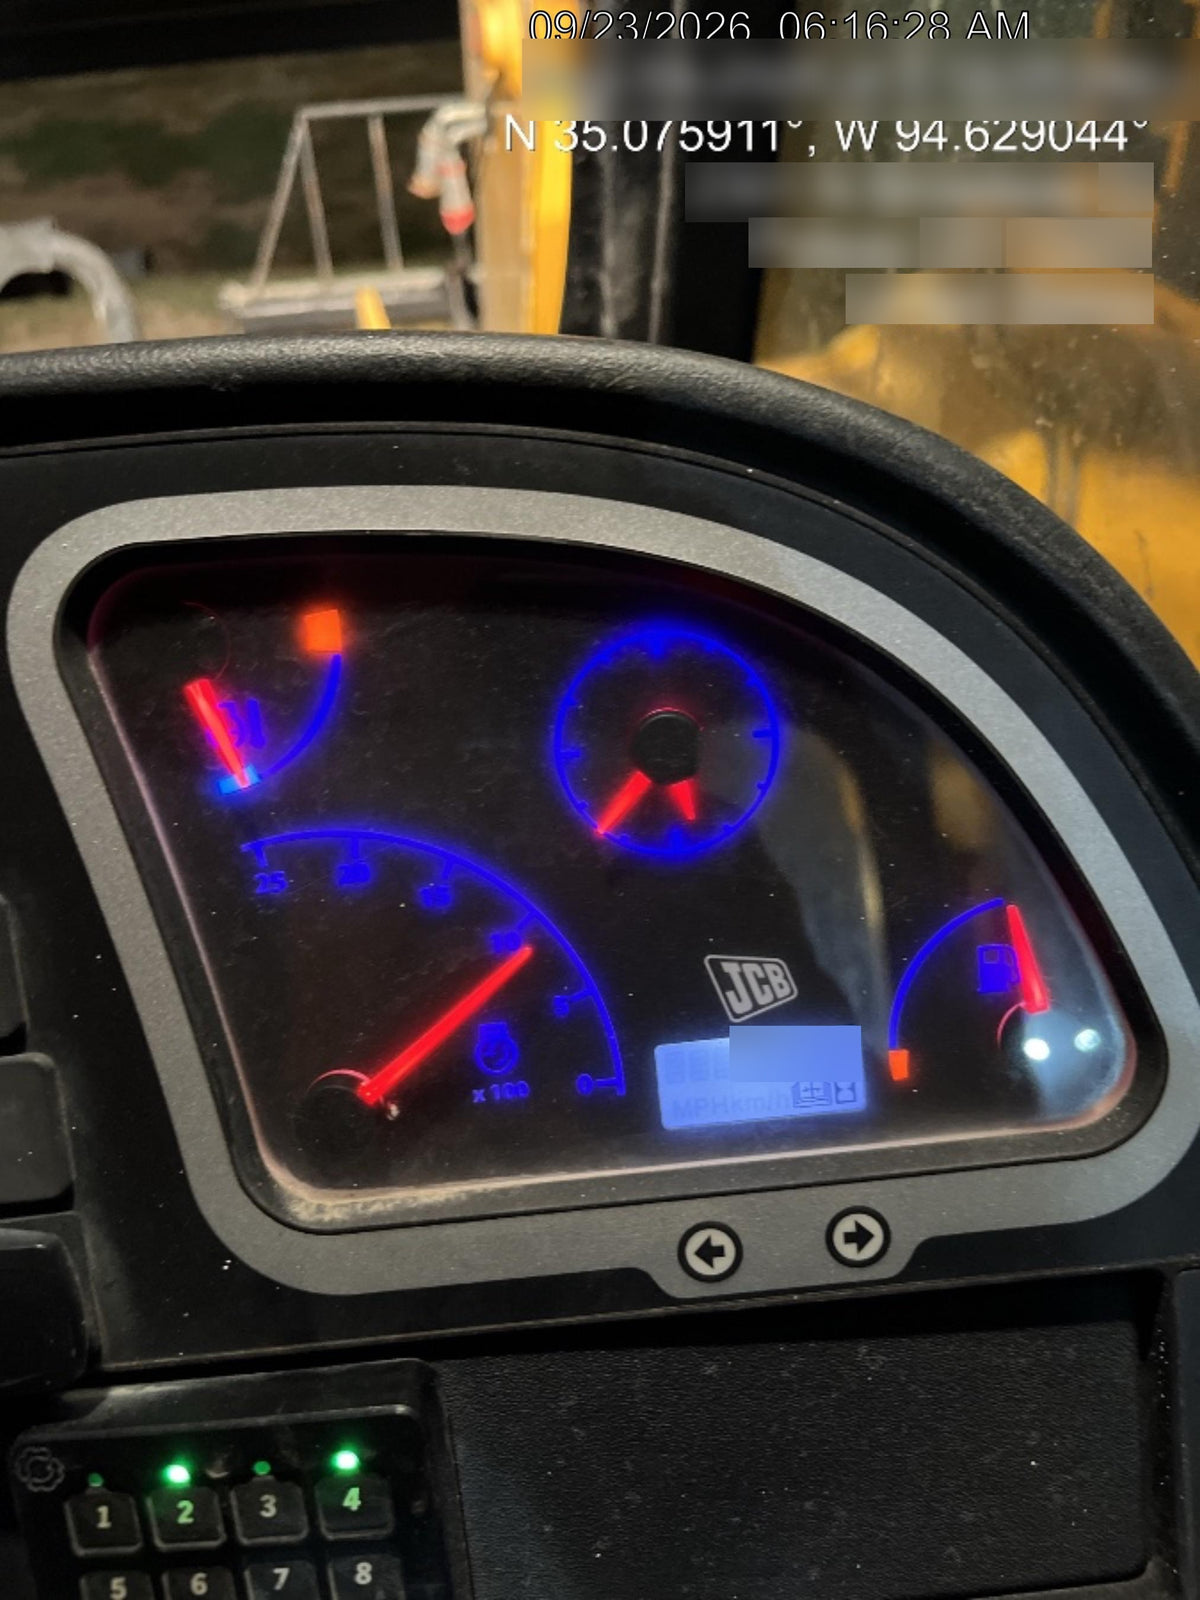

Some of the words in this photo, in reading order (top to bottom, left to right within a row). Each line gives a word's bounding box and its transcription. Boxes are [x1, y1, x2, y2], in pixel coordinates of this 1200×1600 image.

[254, 870, 288, 894] 25
[490, 931, 522, 954] 10
[719, 961, 792, 1015] JCB
[575, 1073, 594, 1095] 0
[258, 1494, 278, 1518] 3
[342, 1487, 362, 1512] 4
[95, 1505, 112, 1529] 1
[176, 1500, 195, 1524] 2
[190, 1573, 209, 1596] 6
[272, 1568, 291, 1591] 7
[354, 1562, 374, 1585] 8
[109, 1576, 128, 1600] 5
